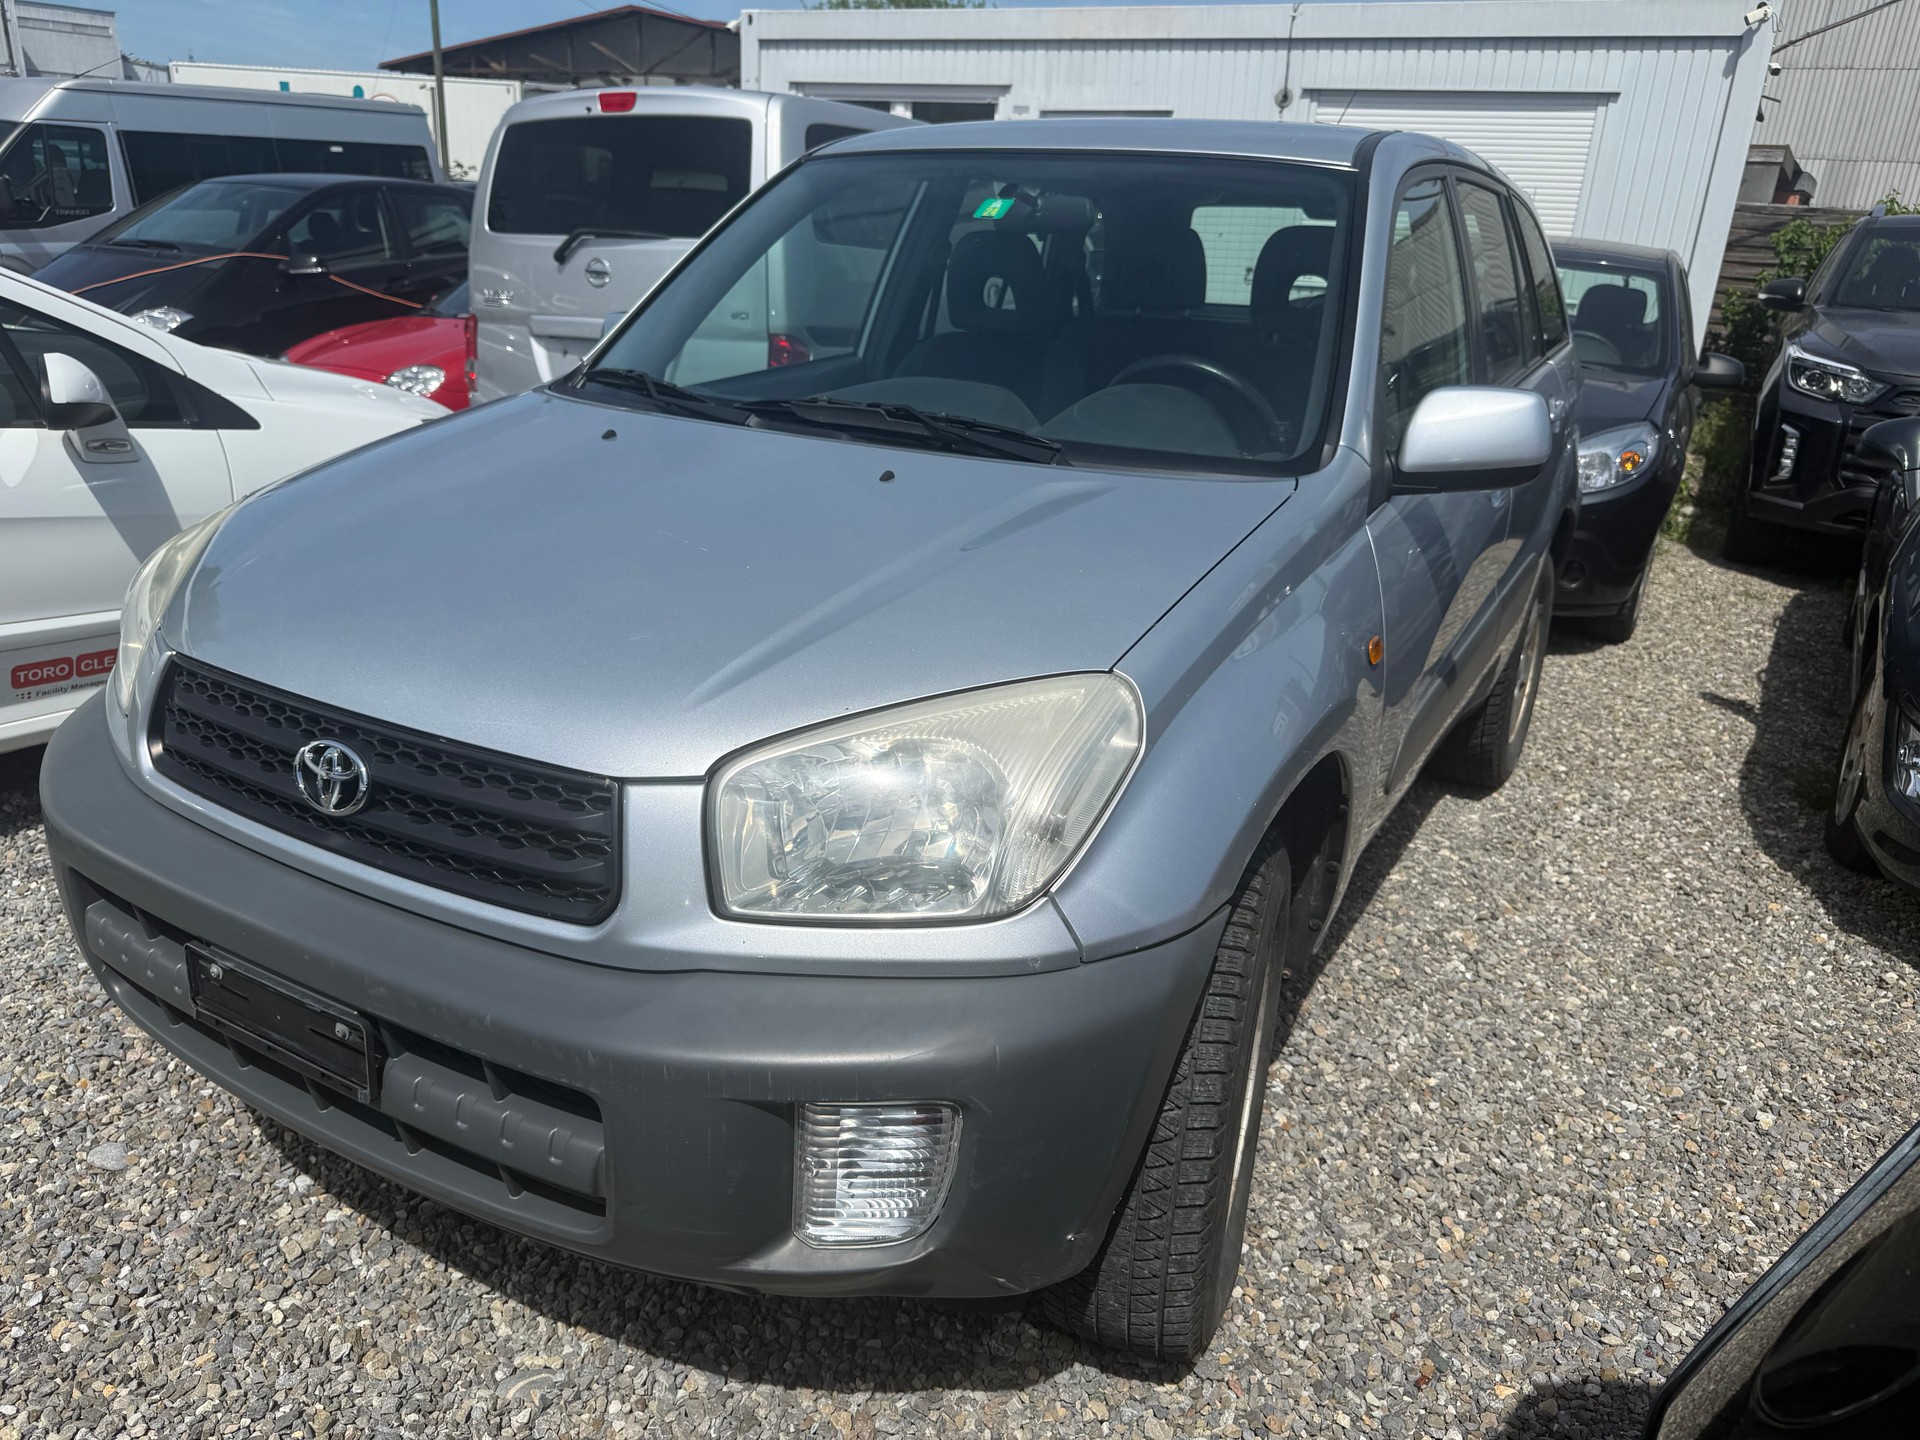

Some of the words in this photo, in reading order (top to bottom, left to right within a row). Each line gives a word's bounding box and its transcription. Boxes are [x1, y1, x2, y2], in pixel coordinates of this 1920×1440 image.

[16, 664, 69, 683] TORO
[81, 655, 115, 672] CLE
[36, 686, 69, 698] Facility
